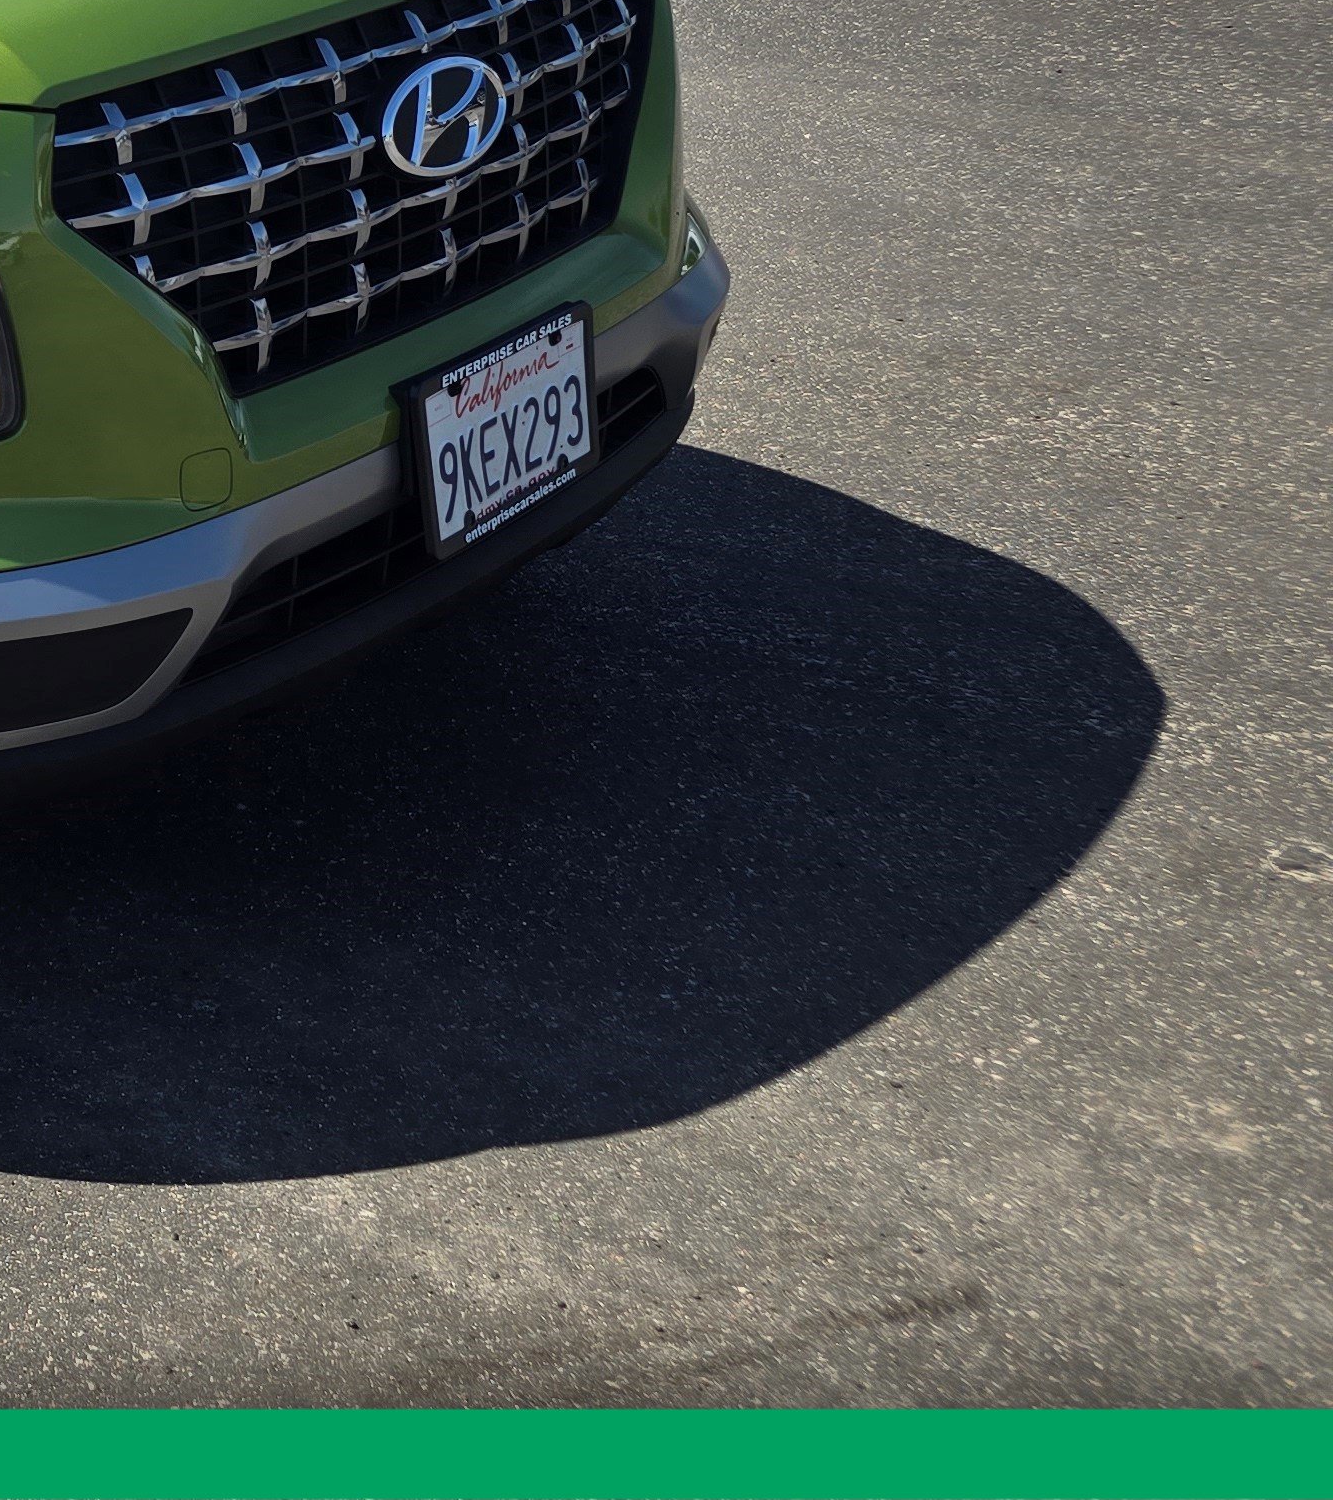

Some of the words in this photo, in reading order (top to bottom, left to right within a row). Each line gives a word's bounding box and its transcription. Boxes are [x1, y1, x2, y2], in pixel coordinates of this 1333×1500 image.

[442, 342, 514, 388] ENTERPRISE
[515, 330, 537, 351] CAR
[539, 313, 572, 339] SALES
[455, 351, 560, 419] California
[438, 374, 583, 524] 9KEX293
[465, 467, 577, 544] enterprisecarsales.com
